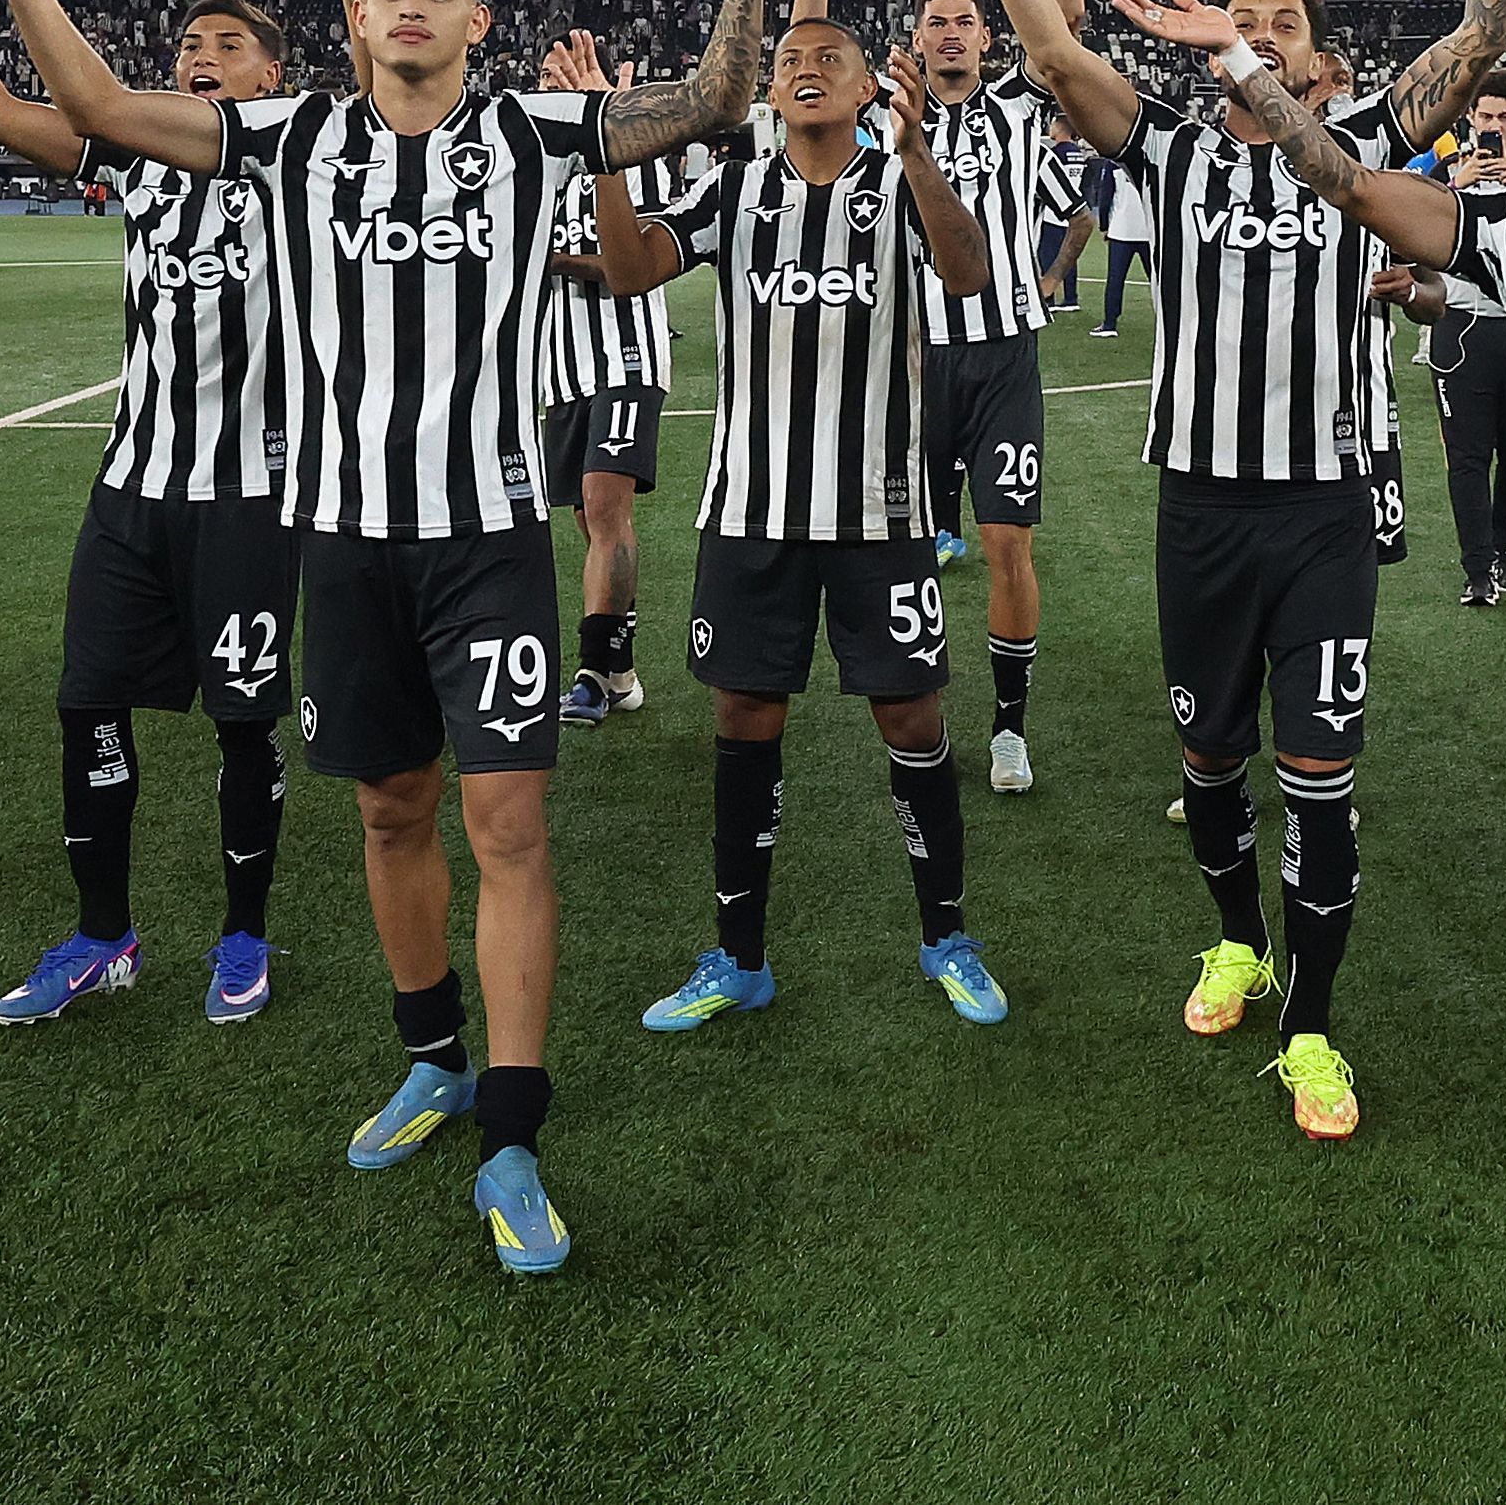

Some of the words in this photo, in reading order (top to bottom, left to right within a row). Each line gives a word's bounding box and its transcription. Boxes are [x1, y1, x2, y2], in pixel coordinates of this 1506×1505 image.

[333, 208, 493, 261] vbet
[1195, 206, 1324, 249] vbet
[749, 262, 875, 306] vbet
[610, 400, 638, 440] 11
[994, 442, 1039, 487] 26
[889, 577, 944, 643] 59
[211, 611, 278, 672] 42
[470, 634, 547, 711] 79
[1316, 638, 1369, 703] 13
